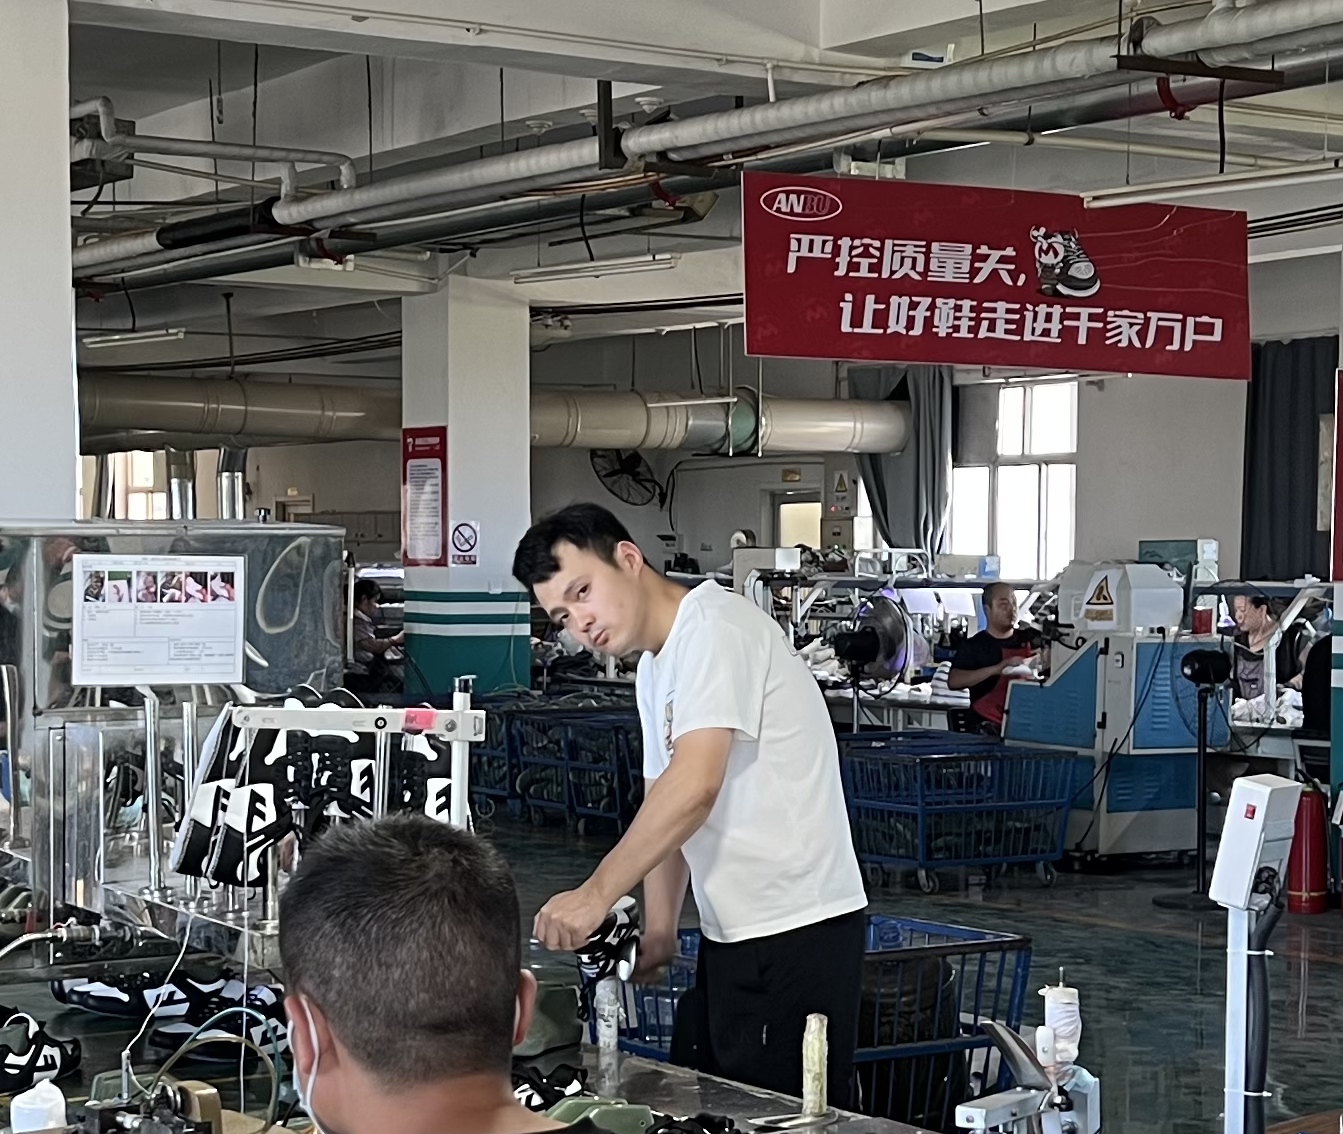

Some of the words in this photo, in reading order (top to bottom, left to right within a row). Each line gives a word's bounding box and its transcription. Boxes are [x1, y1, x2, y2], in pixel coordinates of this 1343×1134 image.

[786, 233, 1028, 288] 严控质量关,
[839, 293, 1224, 352] 让好鞋走进千家万户
